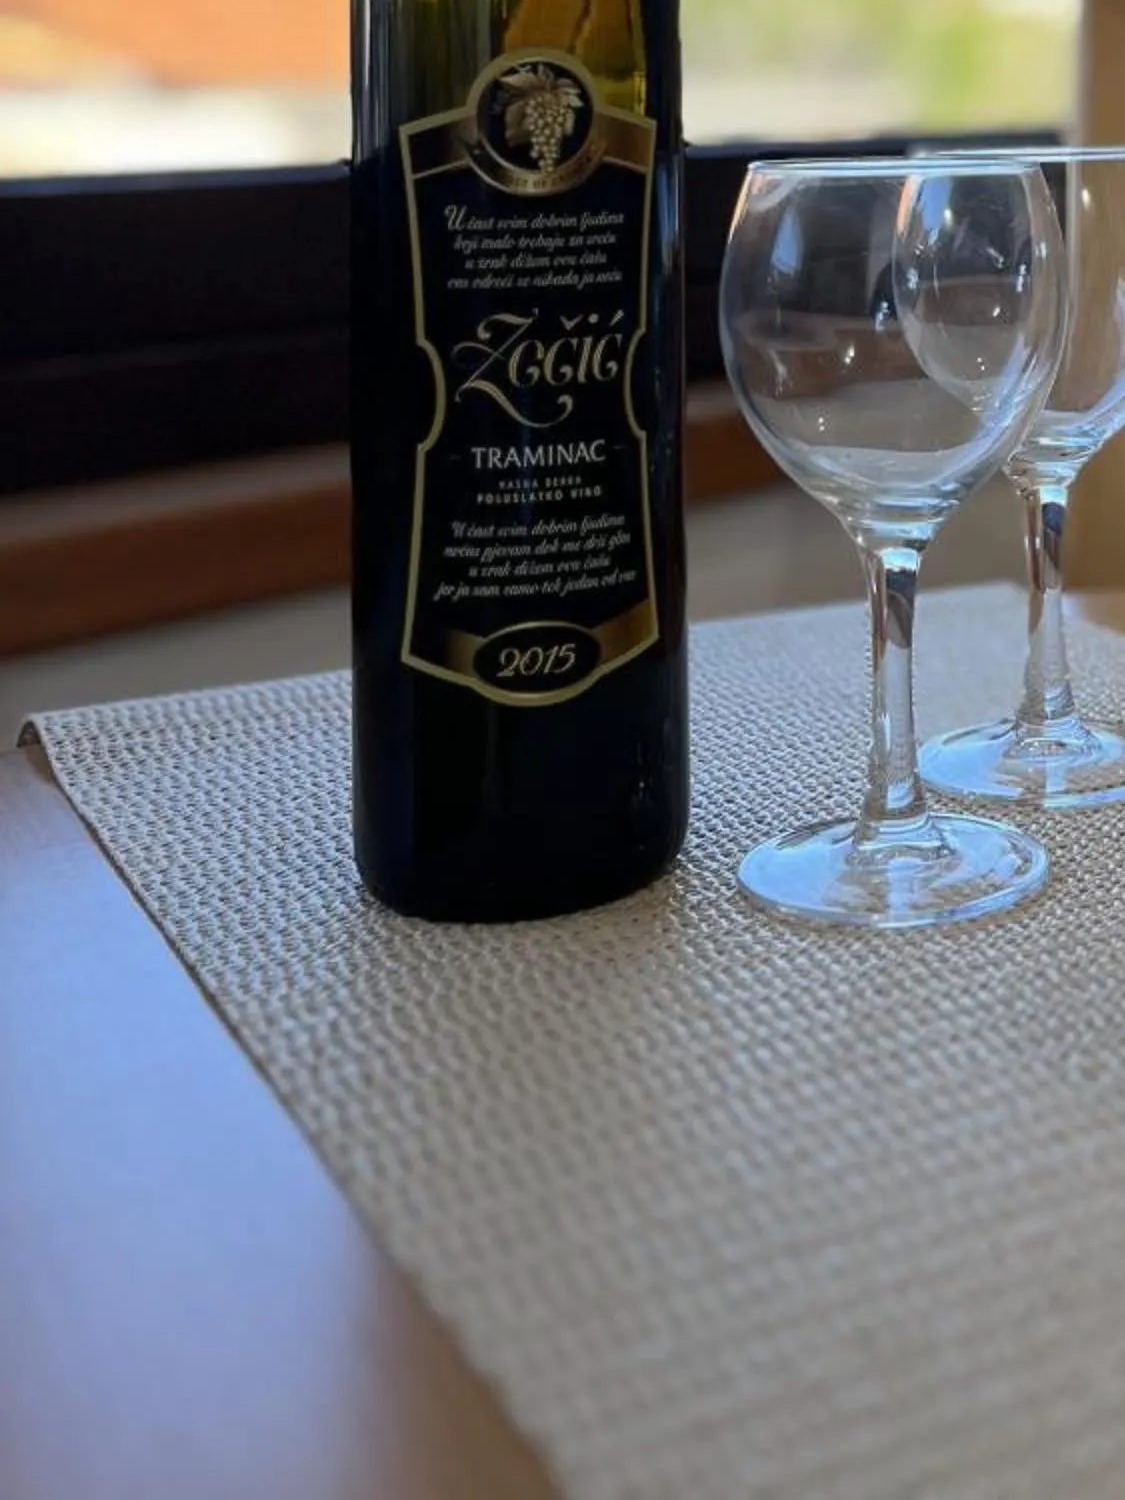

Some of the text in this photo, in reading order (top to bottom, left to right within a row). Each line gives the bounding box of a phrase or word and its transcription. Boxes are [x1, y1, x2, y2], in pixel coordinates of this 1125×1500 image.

[470, 438, 606, 469] TRAMINAC
[476, 484, 602, 505] POLUSLATKO VINO
[496, 644, 576, 678] 2015
